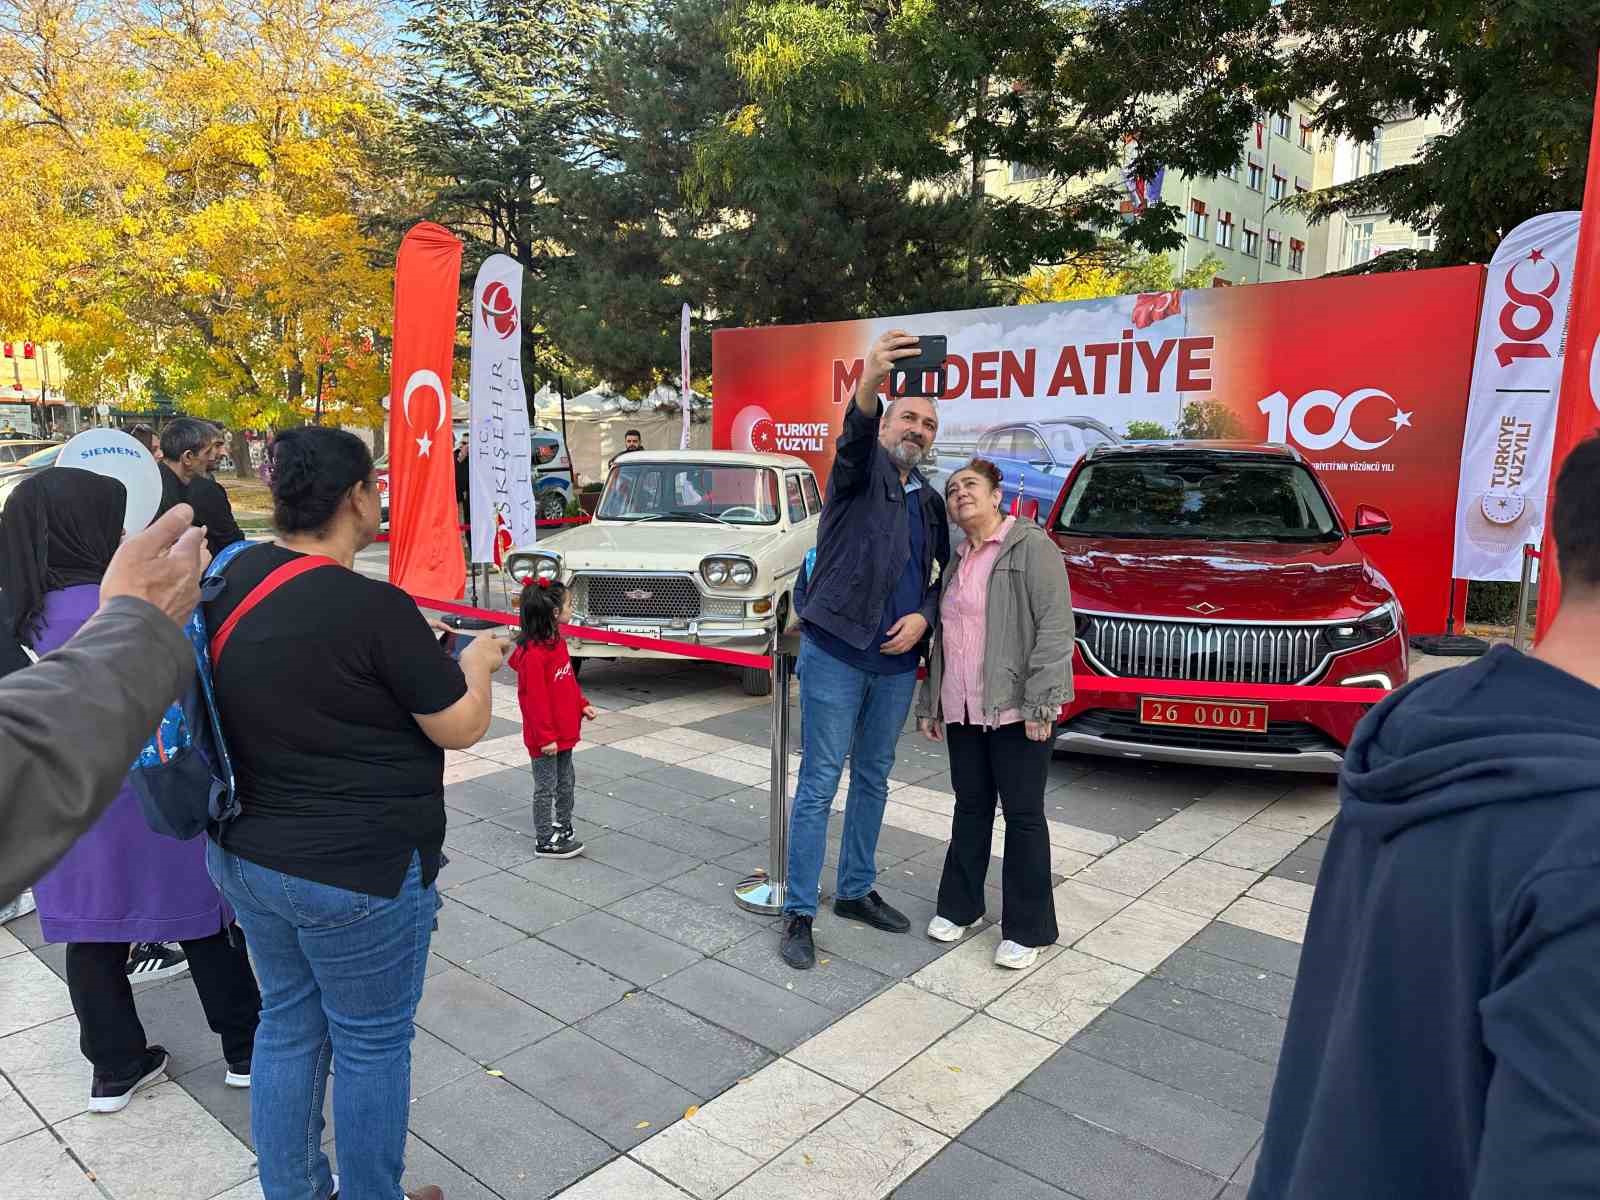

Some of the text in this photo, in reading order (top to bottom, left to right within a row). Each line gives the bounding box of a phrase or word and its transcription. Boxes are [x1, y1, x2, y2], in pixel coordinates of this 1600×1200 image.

[833, 329, 1214, 402] MDEN ATİYE
[81, 447, 141, 459] SIEMENS
[1152, 703, 1256, 727] 26 0001
